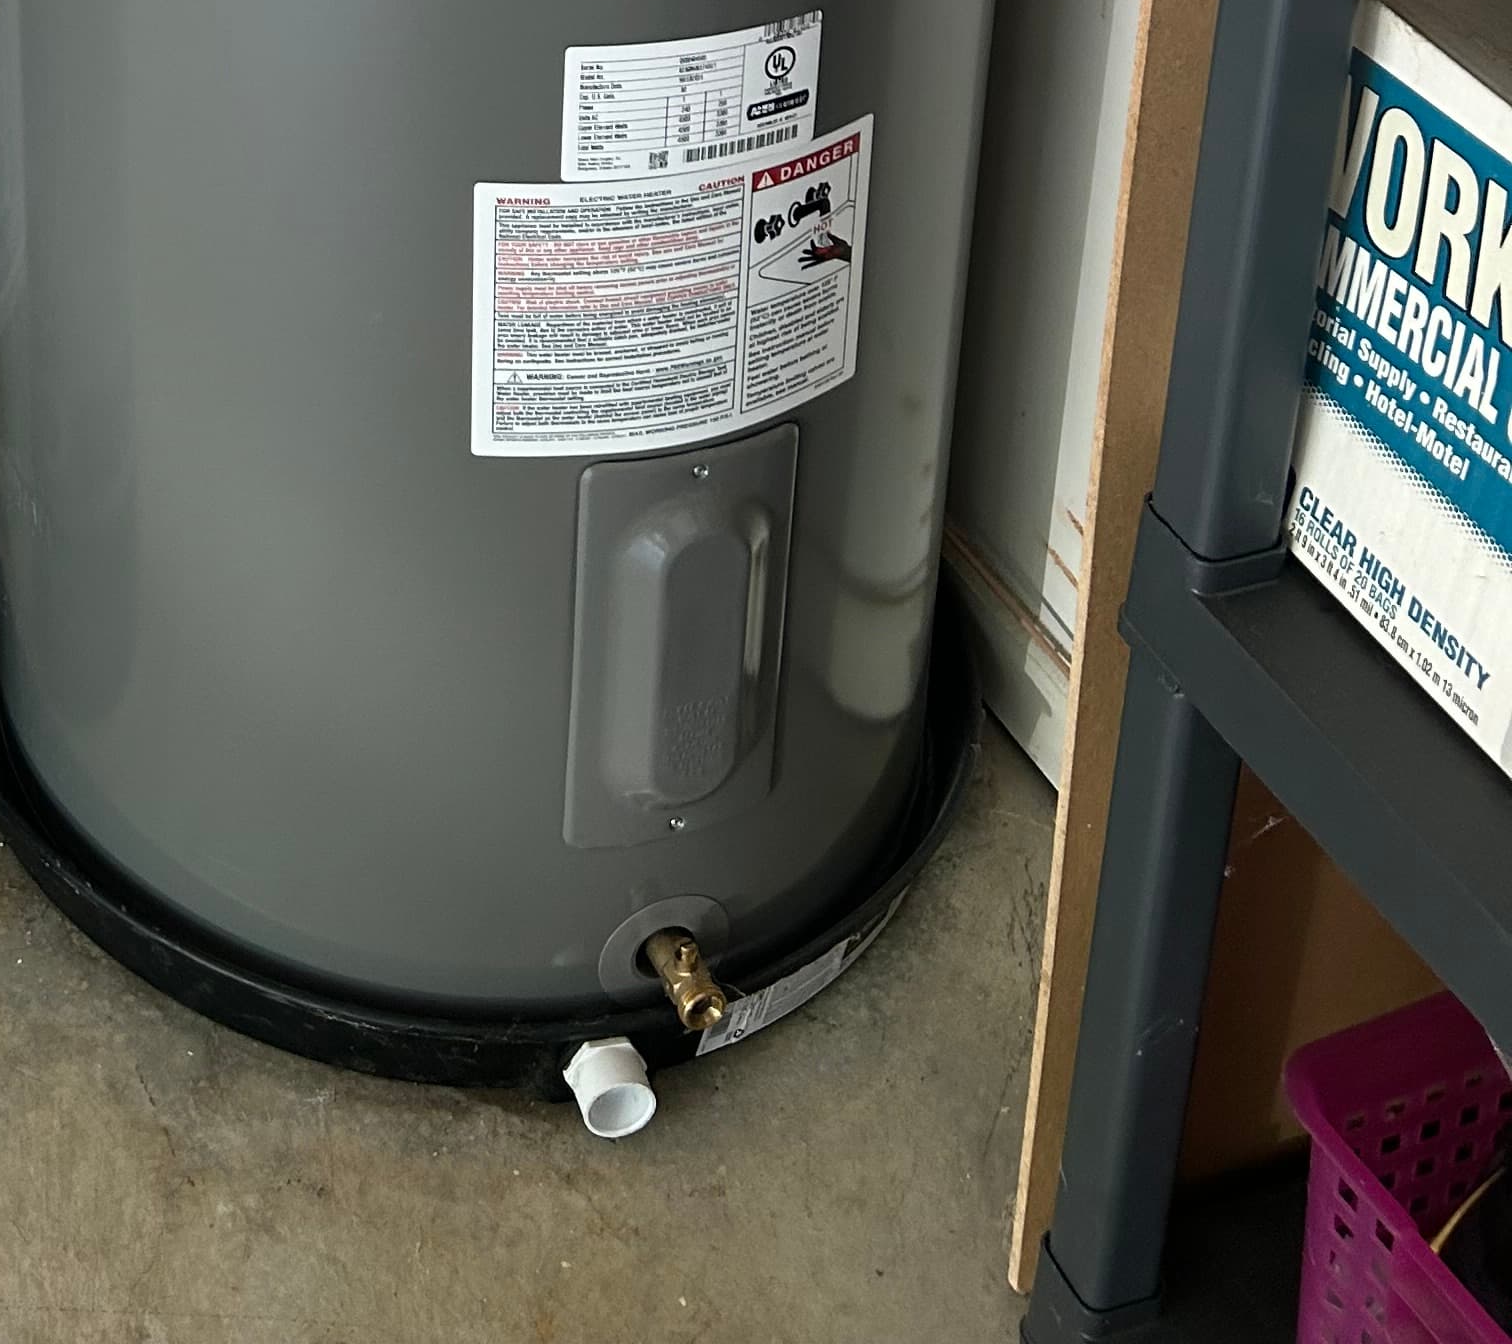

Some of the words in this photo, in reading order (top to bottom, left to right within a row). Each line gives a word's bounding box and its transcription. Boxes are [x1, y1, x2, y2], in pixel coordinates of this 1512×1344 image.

[771, 52, 789, 73] UL
[698, 175, 746, 192] CAUTION
[780, 138, 855, 182] DANGER
[495, 197, 551, 207] WARNING
[812, 218, 834, 235] HOT
[1312, 308, 1356, 351] orial
[1357, 337, 1417, 401] Supply
[1308, 338, 1350, 386] cling
[1364, 379, 1471, 481] Hotel-Motel
[1294, 507, 1305, 524] 16
[1306, 519, 1340, 560] ROLLS
[1339, 553, 1357, 574] OF
[1354, 570, 1369, 591] 20
[1368, 582, 1399, 621] BAGS
[1299, 485, 1357, 558] CLEAR
[1358, 546, 1407, 607] HIGH
[1407, 595, 1491, 692] DENSITY
[1360, 598, 1373, 618] mil
[1396, 633, 1410, 654] cm
[1442, 678, 1453, 698] 13
[1452, 689, 1481, 727] micron
